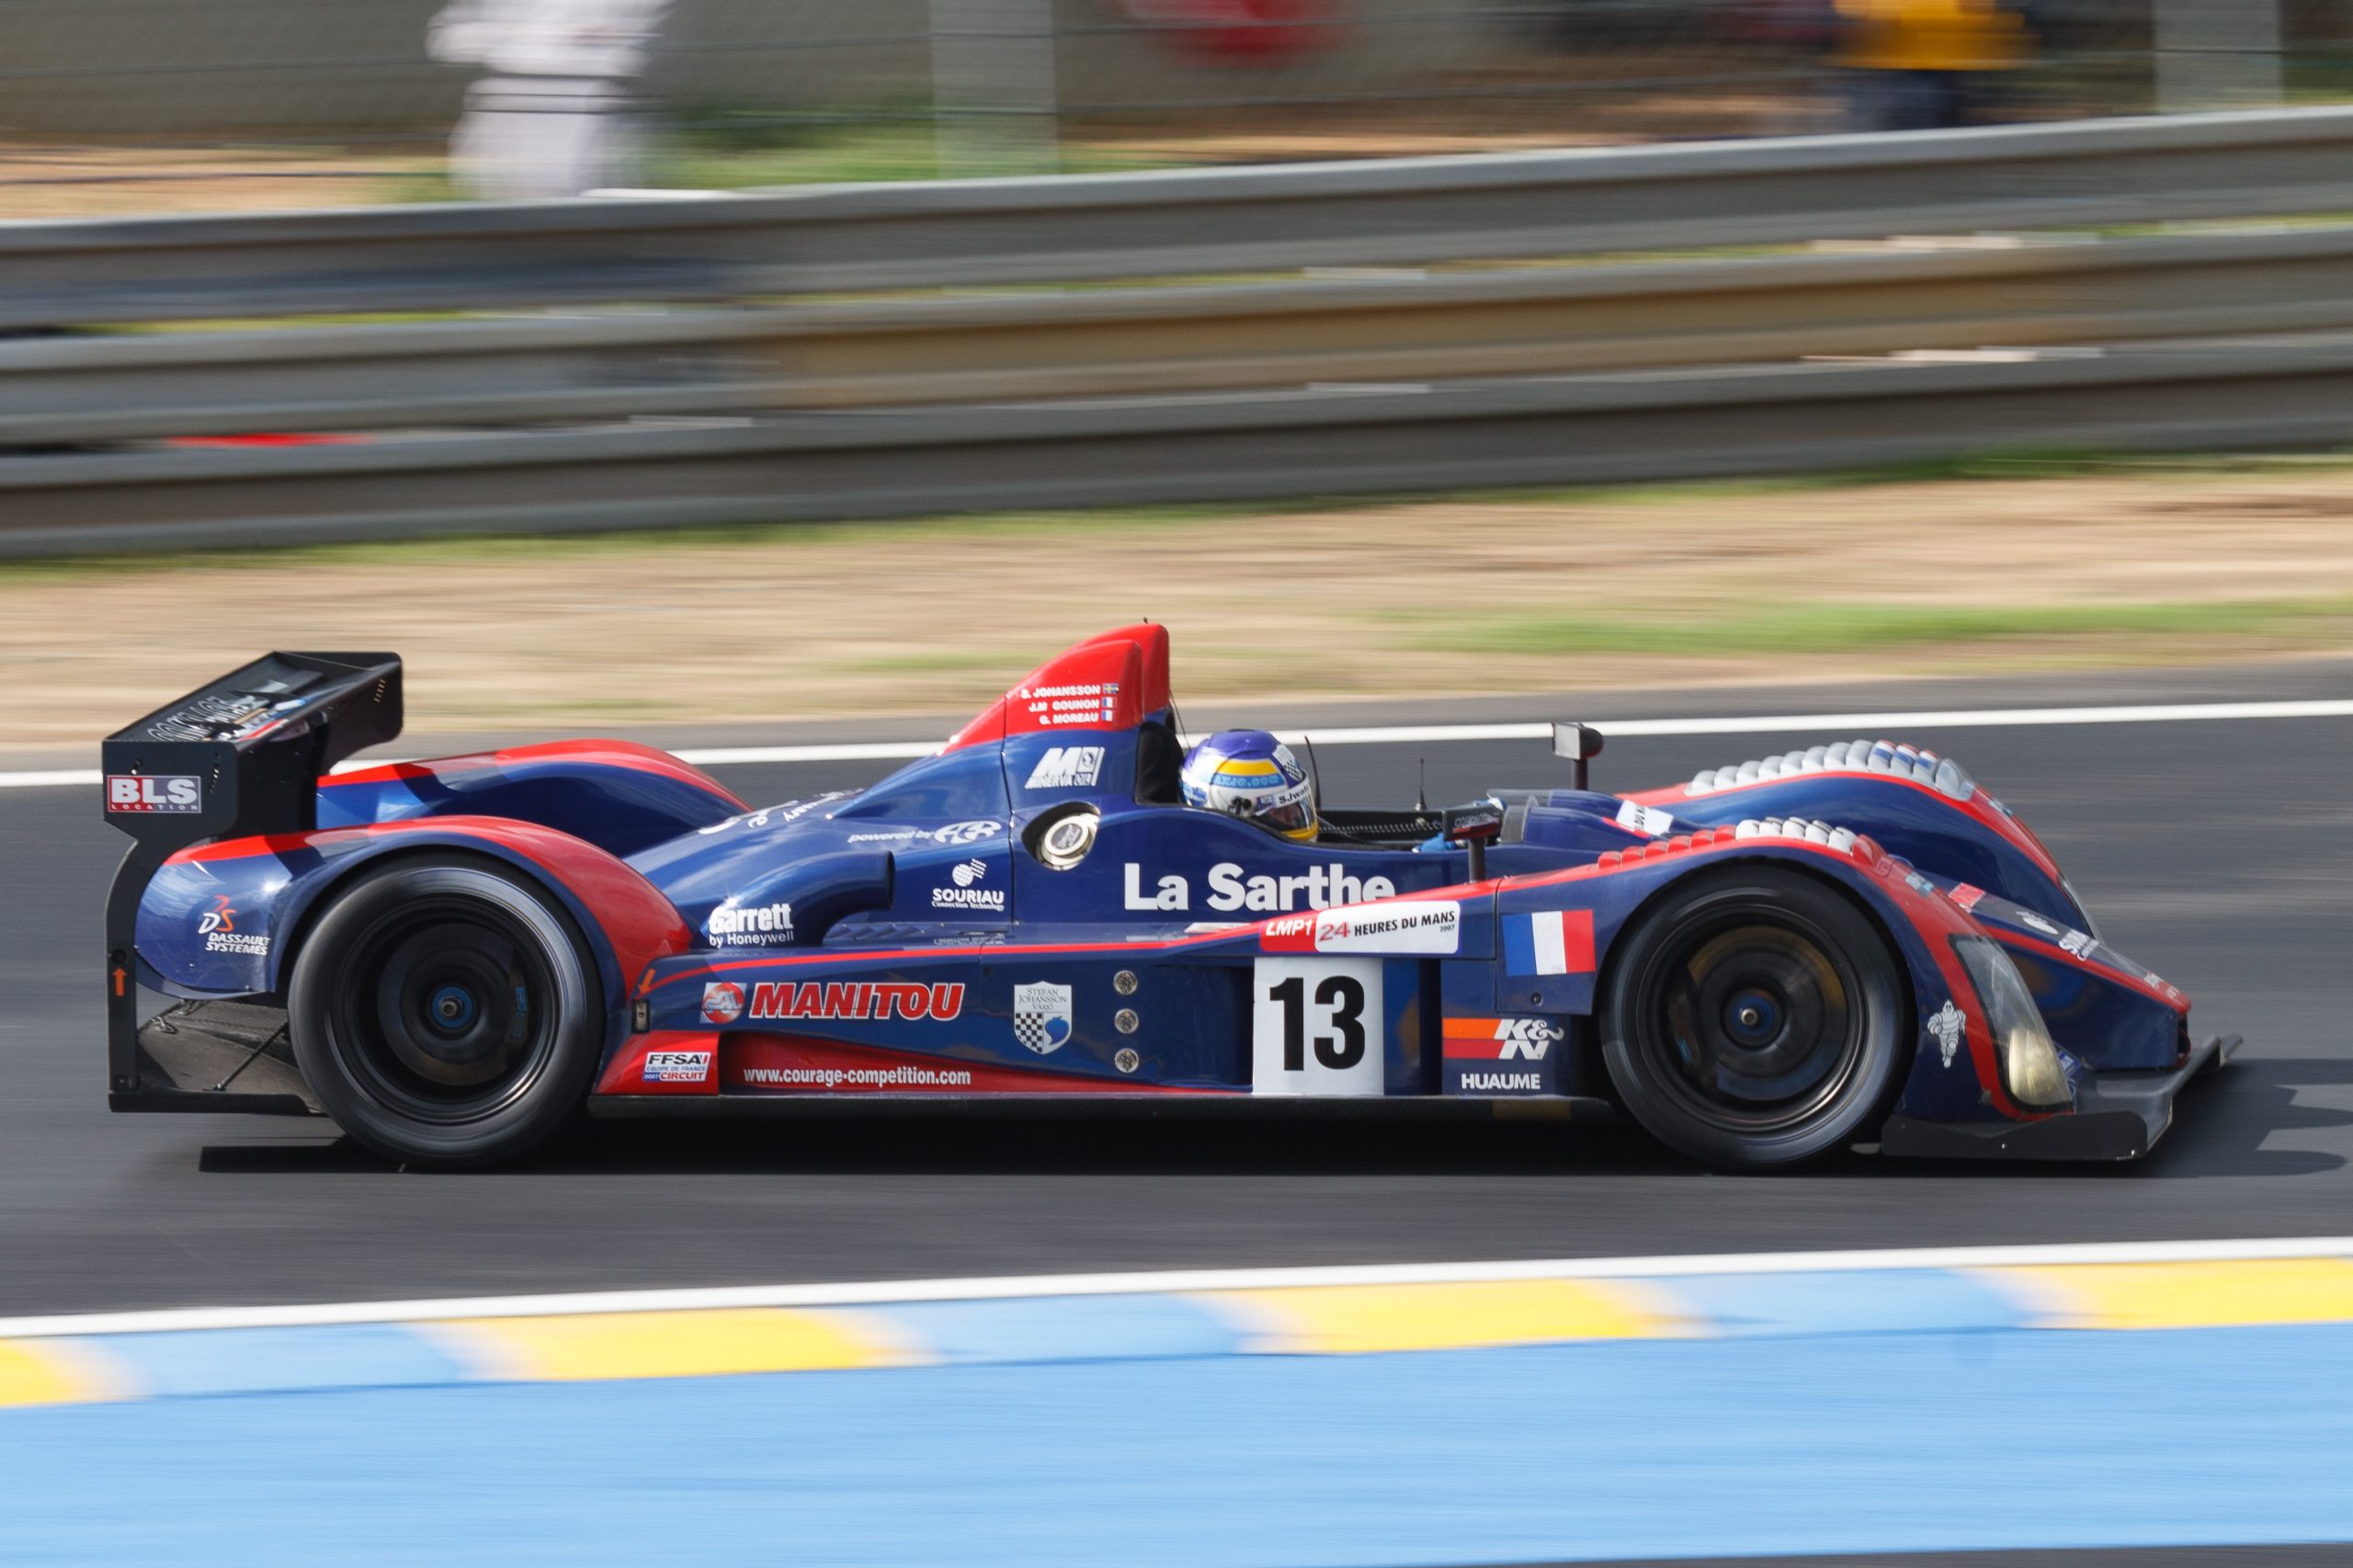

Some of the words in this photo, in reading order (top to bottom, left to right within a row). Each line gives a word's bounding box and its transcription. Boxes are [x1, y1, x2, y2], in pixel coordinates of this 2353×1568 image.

[1033, 685, 1101, 699] JOHANSSON
[1051, 699, 1100, 711] GOUNON
[1052, 711, 1099, 724] MOREAU
[111, 778, 198, 804] BLS
[847, 830, 915, 843] powered
[915, 830, 935, 839] by
[1124, 863, 1189, 911] La
[1206, 863, 1396, 912] Sarthe
[932, 888, 1005, 904] SOURIAU
[709, 903, 794, 935] Garrett
[1318, 922, 1351, 942] 24
[1354, 920, 1398, 937] HEURES
[1402, 917, 1417, 929] DU
[1421, 910, 1455, 926] MANS
[1266, 919, 1314, 937] LMP1
[208, 932, 271, 946] DASSAULT
[709, 934, 723, 949] by
[727, 930, 794, 947] Honeywell
[205, 941, 268, 956] SYSTEMES
[749, 983, 965, 1021] MANITOU
[1269, 975, 1366, 1071] 13
[648, 1054, 701, 1064] FFSA
[660, 1072, 704, 1080] CIRCUIT
[744, 1066, 972, 1087] www.courage-competition.com
[1461, 1074, 1540, 1090] HUAUME
